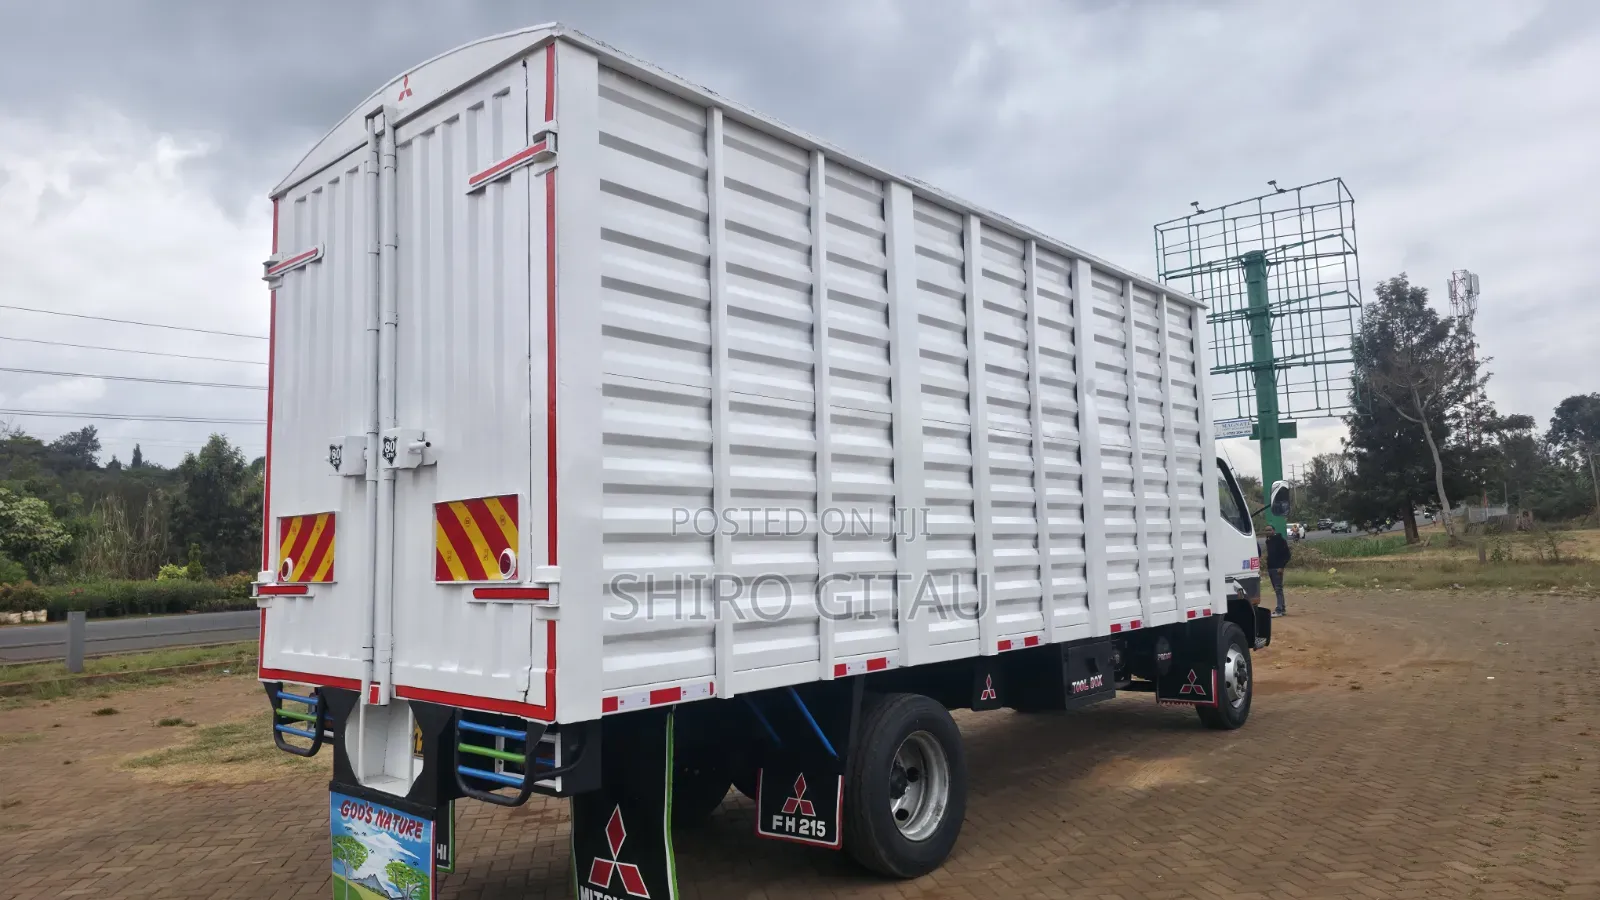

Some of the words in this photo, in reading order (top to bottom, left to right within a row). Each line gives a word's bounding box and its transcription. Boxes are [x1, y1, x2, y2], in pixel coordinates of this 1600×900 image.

[331, 448, 341, 460] 80
[384, 440, 395, 453] 80
[1072, 679, 1089, 693] TOOL
[1090, 674, 1103, 689] BOX
[340, 799, 374, 825] GOD'S
[376, 808, 424, 840] NATURE
[772, 814, 796, 833] FH
[798, 818, 826, 837] 215
